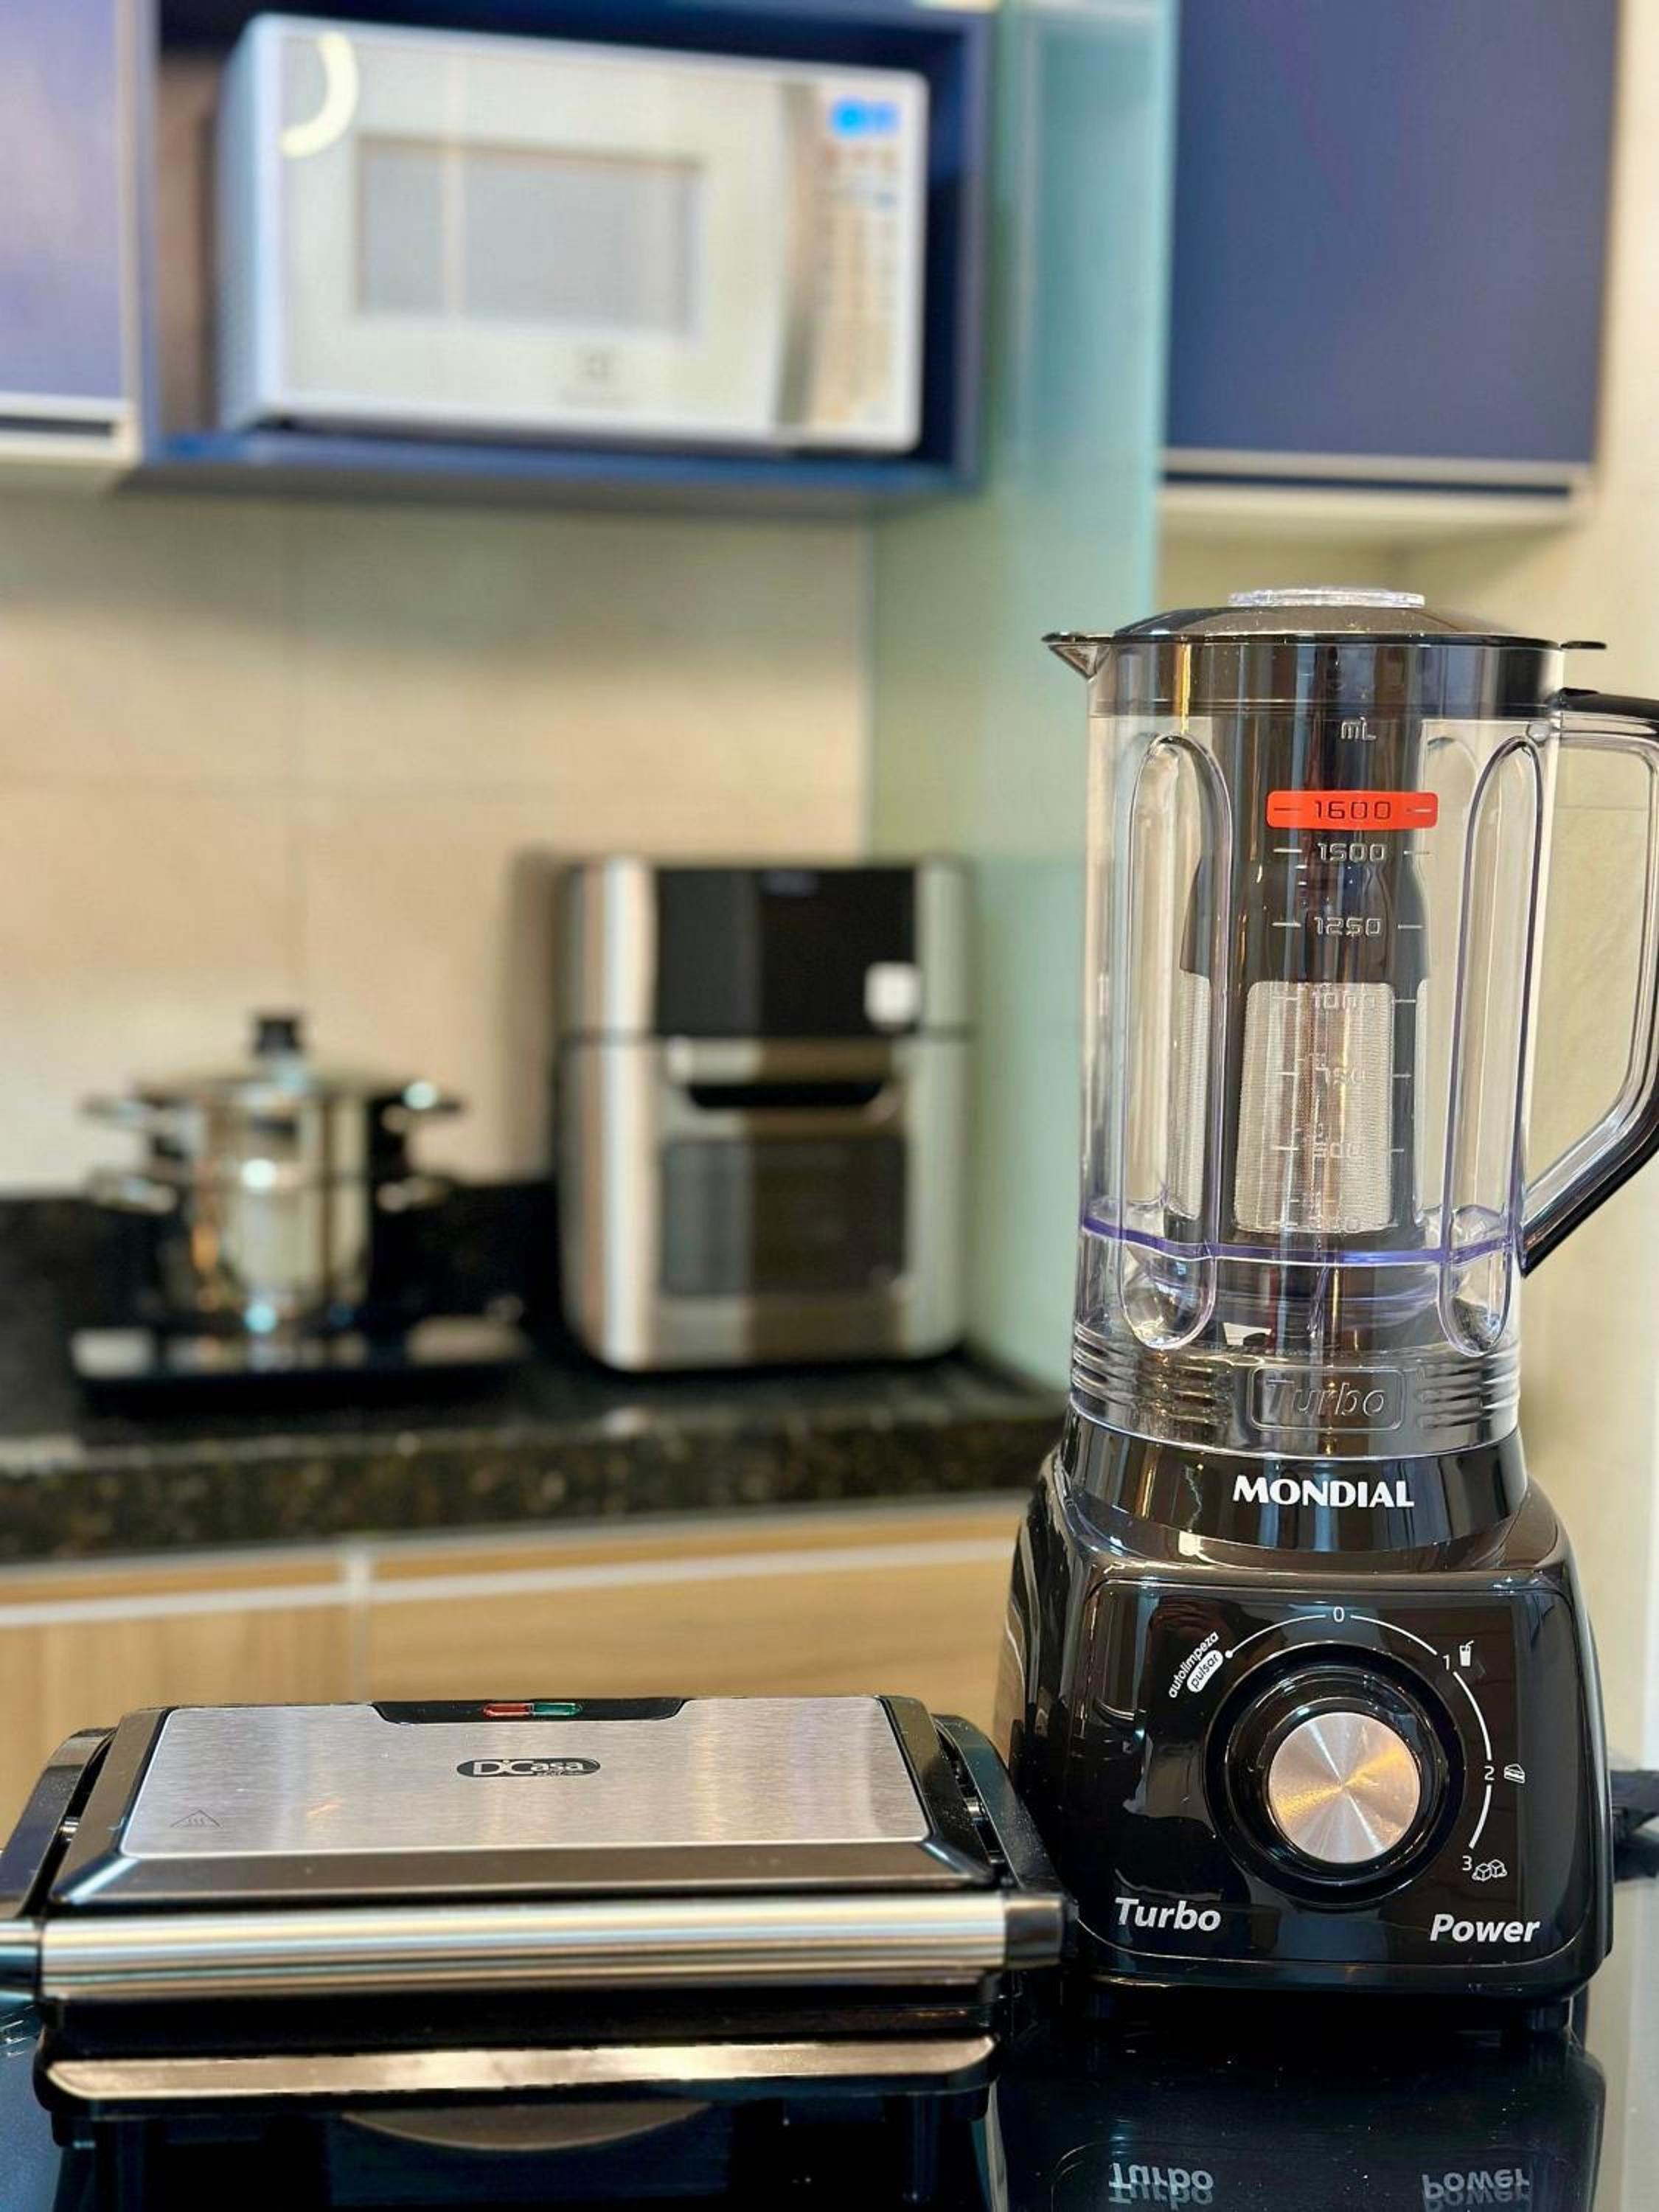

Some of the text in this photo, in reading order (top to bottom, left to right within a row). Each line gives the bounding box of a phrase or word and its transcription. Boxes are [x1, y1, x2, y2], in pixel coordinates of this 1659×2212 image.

[1314, 801, 1392, 821] 1600
[1317, 843, 1385, 863] 1500
[1313, 917, 1382, 936] 1250
[1265, 1379, 1385, 1416] Turbo
[1232, 1475, 1415, 1508] MONDIAL
[1332, 1605, 1345, 1623] 0
[1169, 1632, 1219, 1698] autolimpeza
[1191, 1654, 1218, 1689] pulsar
[1442, 1654, 1450, 1670] 1
[1484, 1766, 1495, 1781] 2
[1461, 1855, 1472, 1871] 3
[1115, 1897, 1221, 1932] Turbo
[1430, 1913, 1540, 1944] Power
